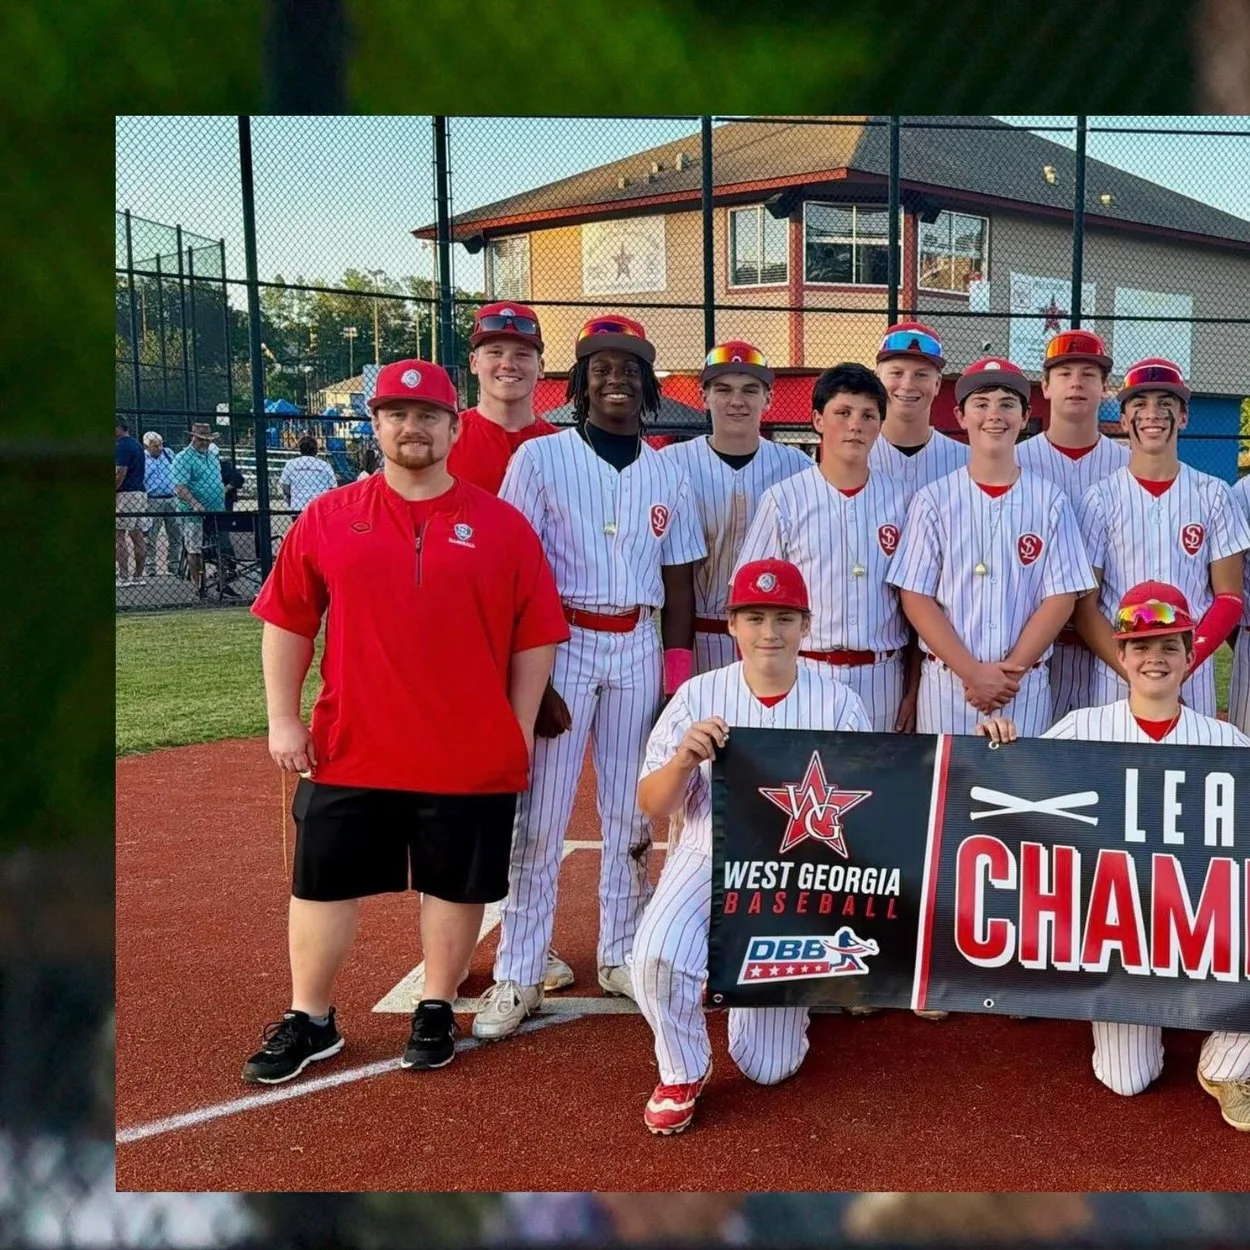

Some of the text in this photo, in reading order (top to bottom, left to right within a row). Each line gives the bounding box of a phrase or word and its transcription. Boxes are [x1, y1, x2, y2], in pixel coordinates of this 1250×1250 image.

[724, 861, 900, 896] WEST GEORGIA
[724, 891, 898, 919] BASEBALL
[748, 939, 826, 960] DBB
